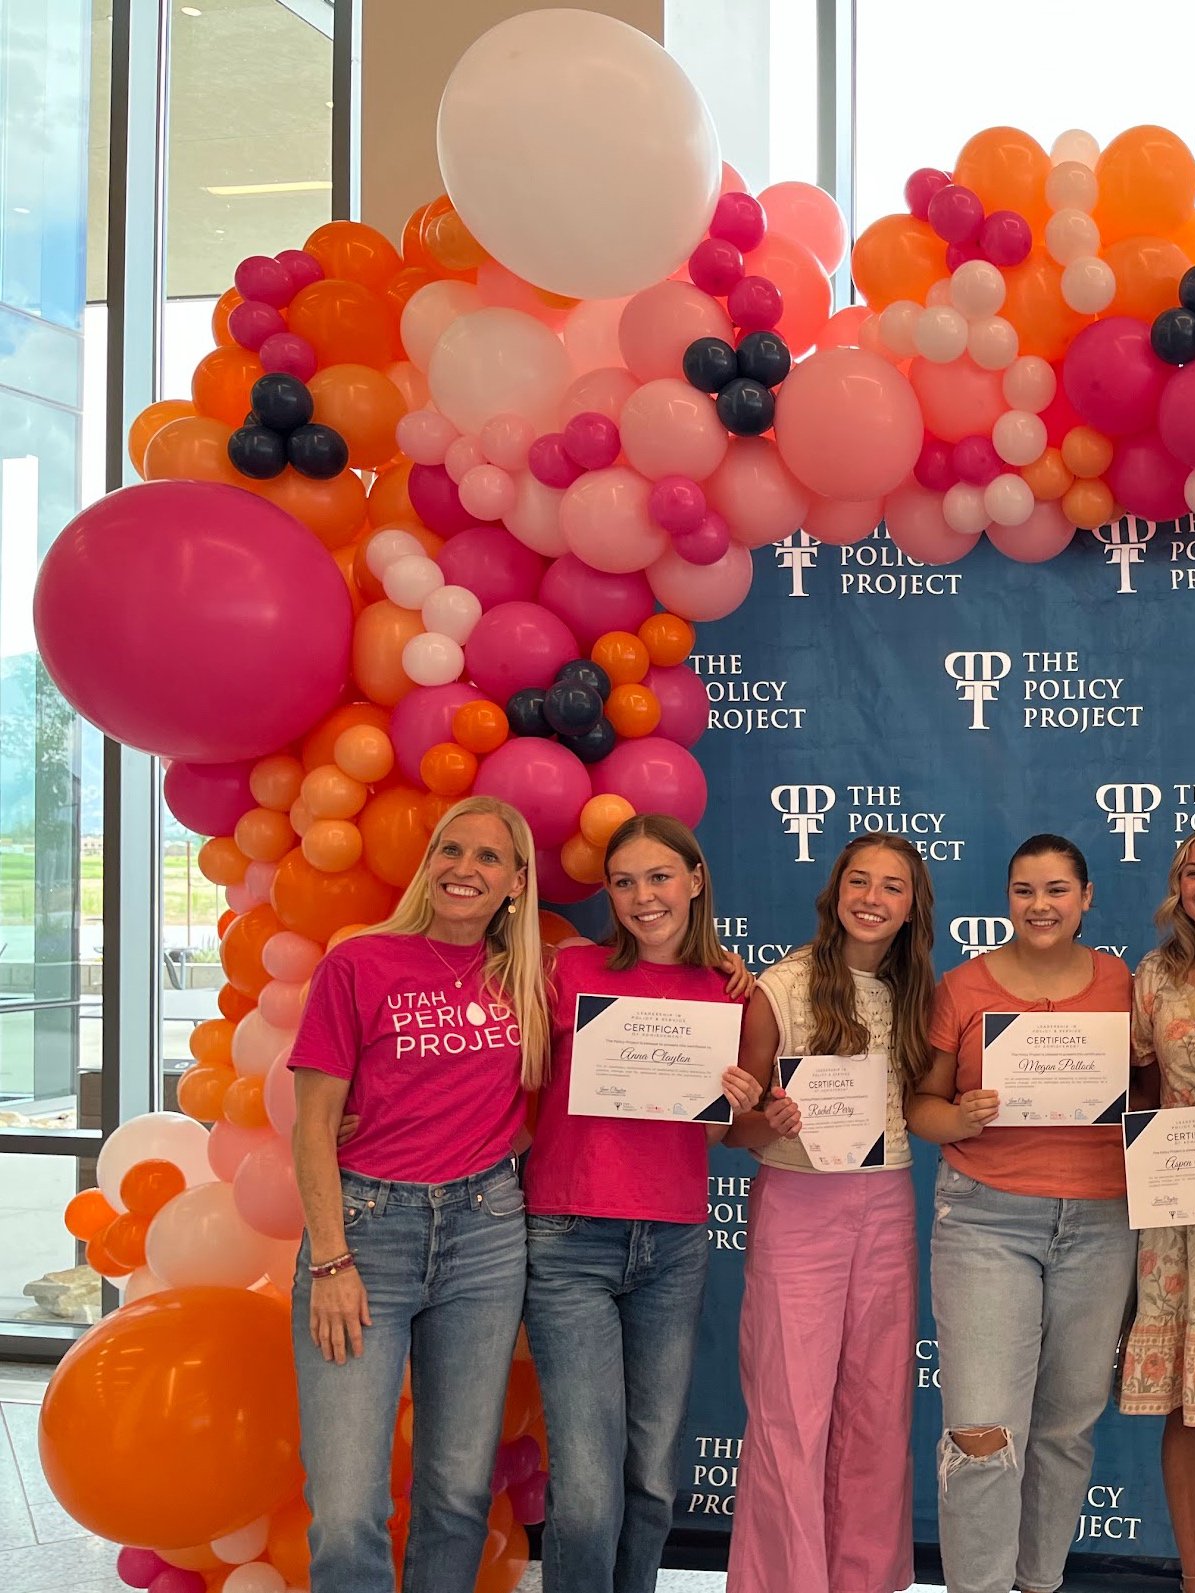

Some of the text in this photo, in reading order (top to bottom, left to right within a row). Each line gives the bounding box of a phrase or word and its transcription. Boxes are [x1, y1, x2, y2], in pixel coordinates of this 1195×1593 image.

[840, 545, 938, 567] POLI
[841, 573, 962, 600] PROJECT
[688, 654, 743, 675] THE
[1022, 651, 1079, 673] THE
[705, 681, 787, 702] OLICY
[1023, 678, 1125, 701] POLICY
[706, 708, 807, 735] ROJECT
[1023, 706, 1144, 734] PROJECT
[847, 785, 901, 807] THE
[848, 812, 946, 834] POLICY
[713, 917, 748, 937] HE
[387, 990, 447, 1009] UTAH
[623, 1022, 692, 1036] CERTIFICATE
[396, 1024, 521, 1060] PROJEC
[1026, 1036, 1088, 1045] CERTIFICATE
[620, 1046, 691, 1067] Anna Clayton
[1018, 1058, 1096, 1074] Megan Pollock
[808, 1079, 855, 1089] CERTIFICATE
[1165, 1155, 1192, 1171] Aspen
[1075, 1514, 1142, 1543] JECT
